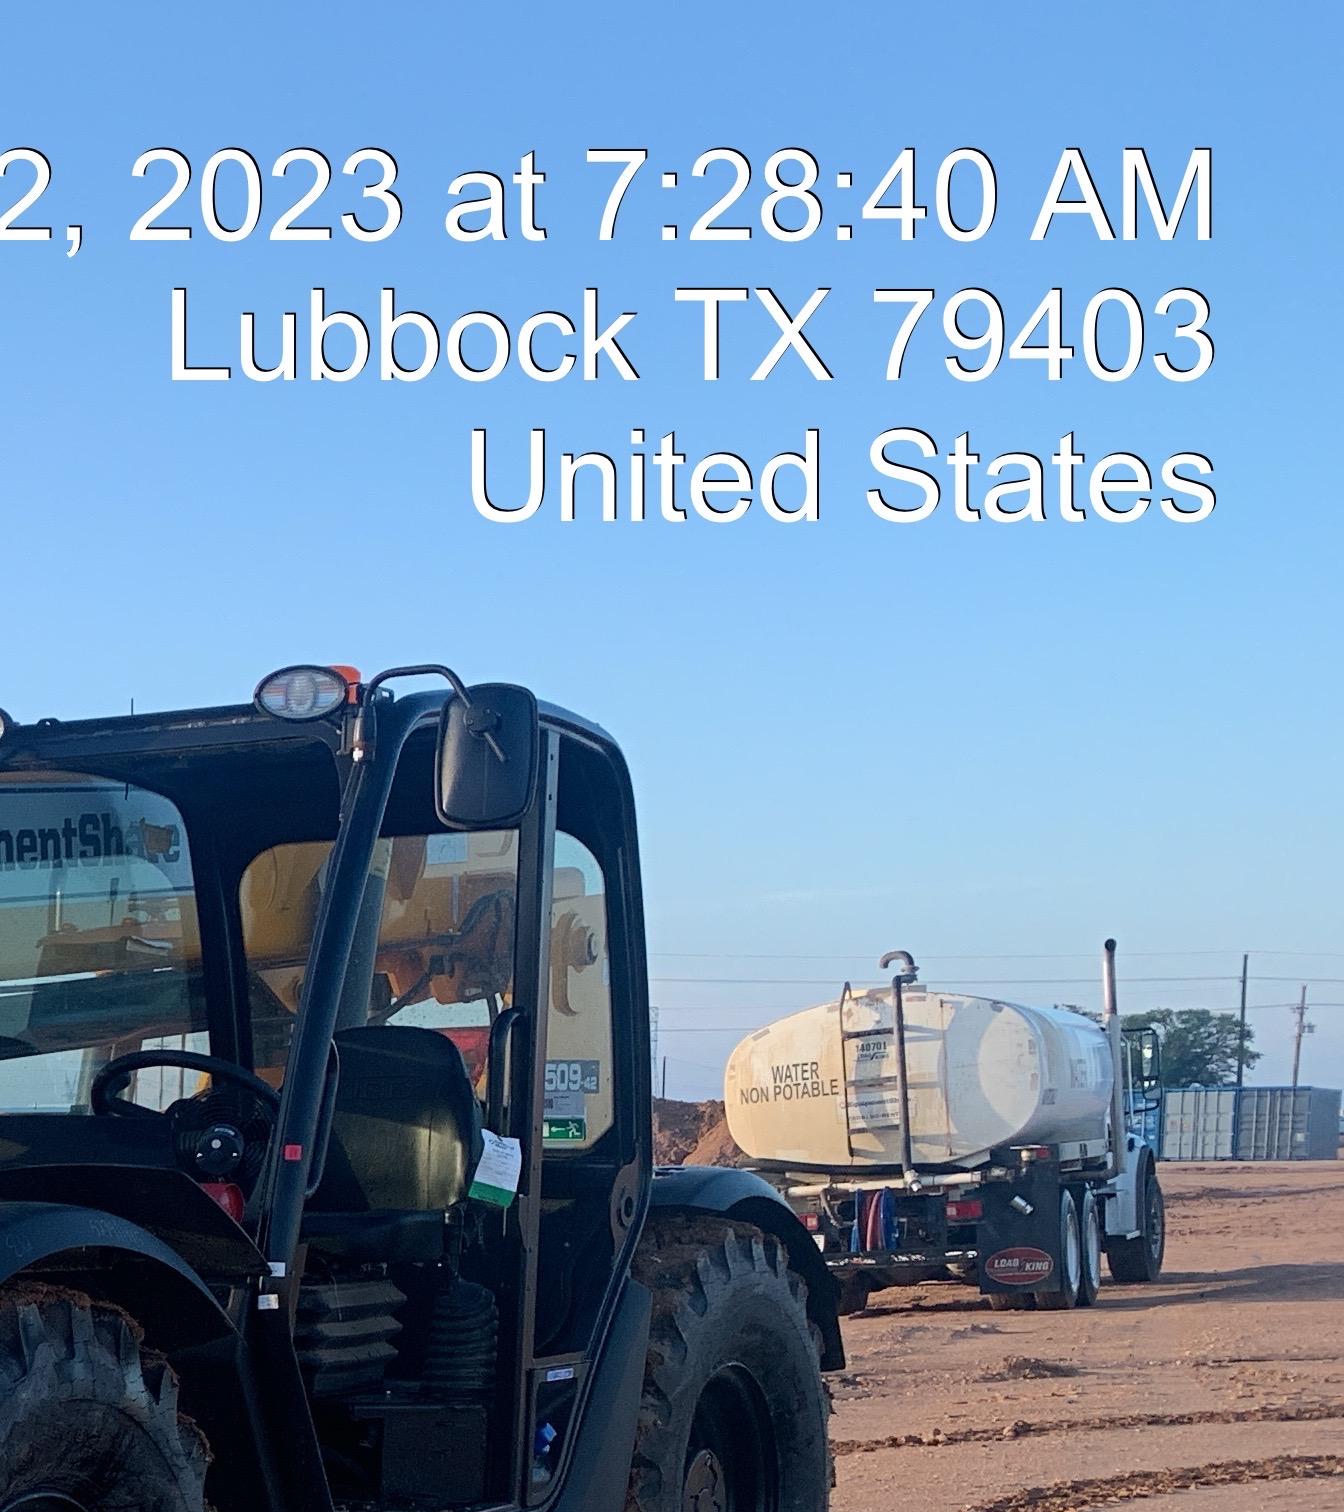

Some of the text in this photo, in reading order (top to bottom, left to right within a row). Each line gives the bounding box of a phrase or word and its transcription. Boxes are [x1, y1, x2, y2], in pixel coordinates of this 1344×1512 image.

[771, 1062, 820, 1084] WATER
[740, 1079, 840, 1105] NON POTABLE
[993, 1257, 1050, 1272] LOAD KING
